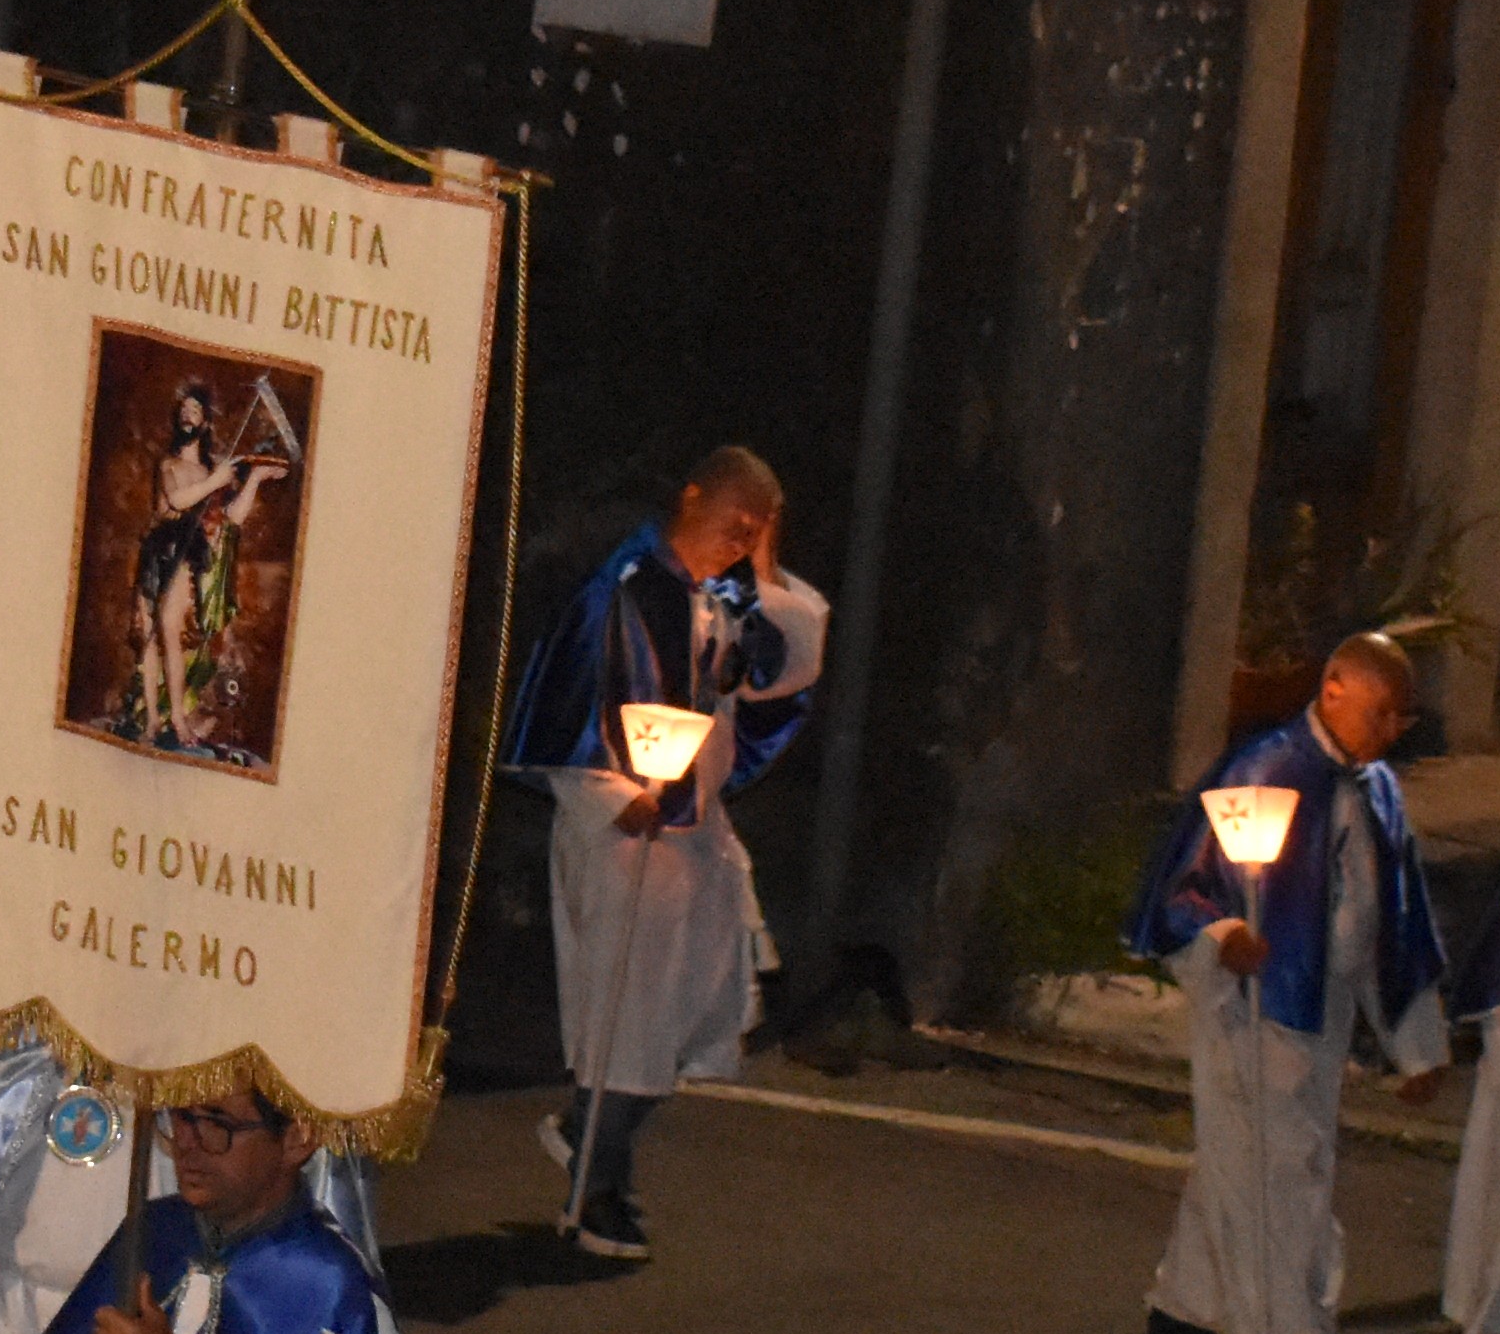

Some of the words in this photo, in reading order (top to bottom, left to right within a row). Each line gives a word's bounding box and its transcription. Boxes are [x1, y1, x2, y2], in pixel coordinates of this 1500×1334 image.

[63, 153, 389, 270] CONFRATERNITA
[1, 221, 70, 279] SAN
[90, 242, 259, 325] GIOVANNI
[282, 284, 432, 365] BATTISTA
[0, 794, 78, 854] SAN
[109, 826, 316, 913] GIOVANNI
[50, 898, 258, 989] GALERMO
